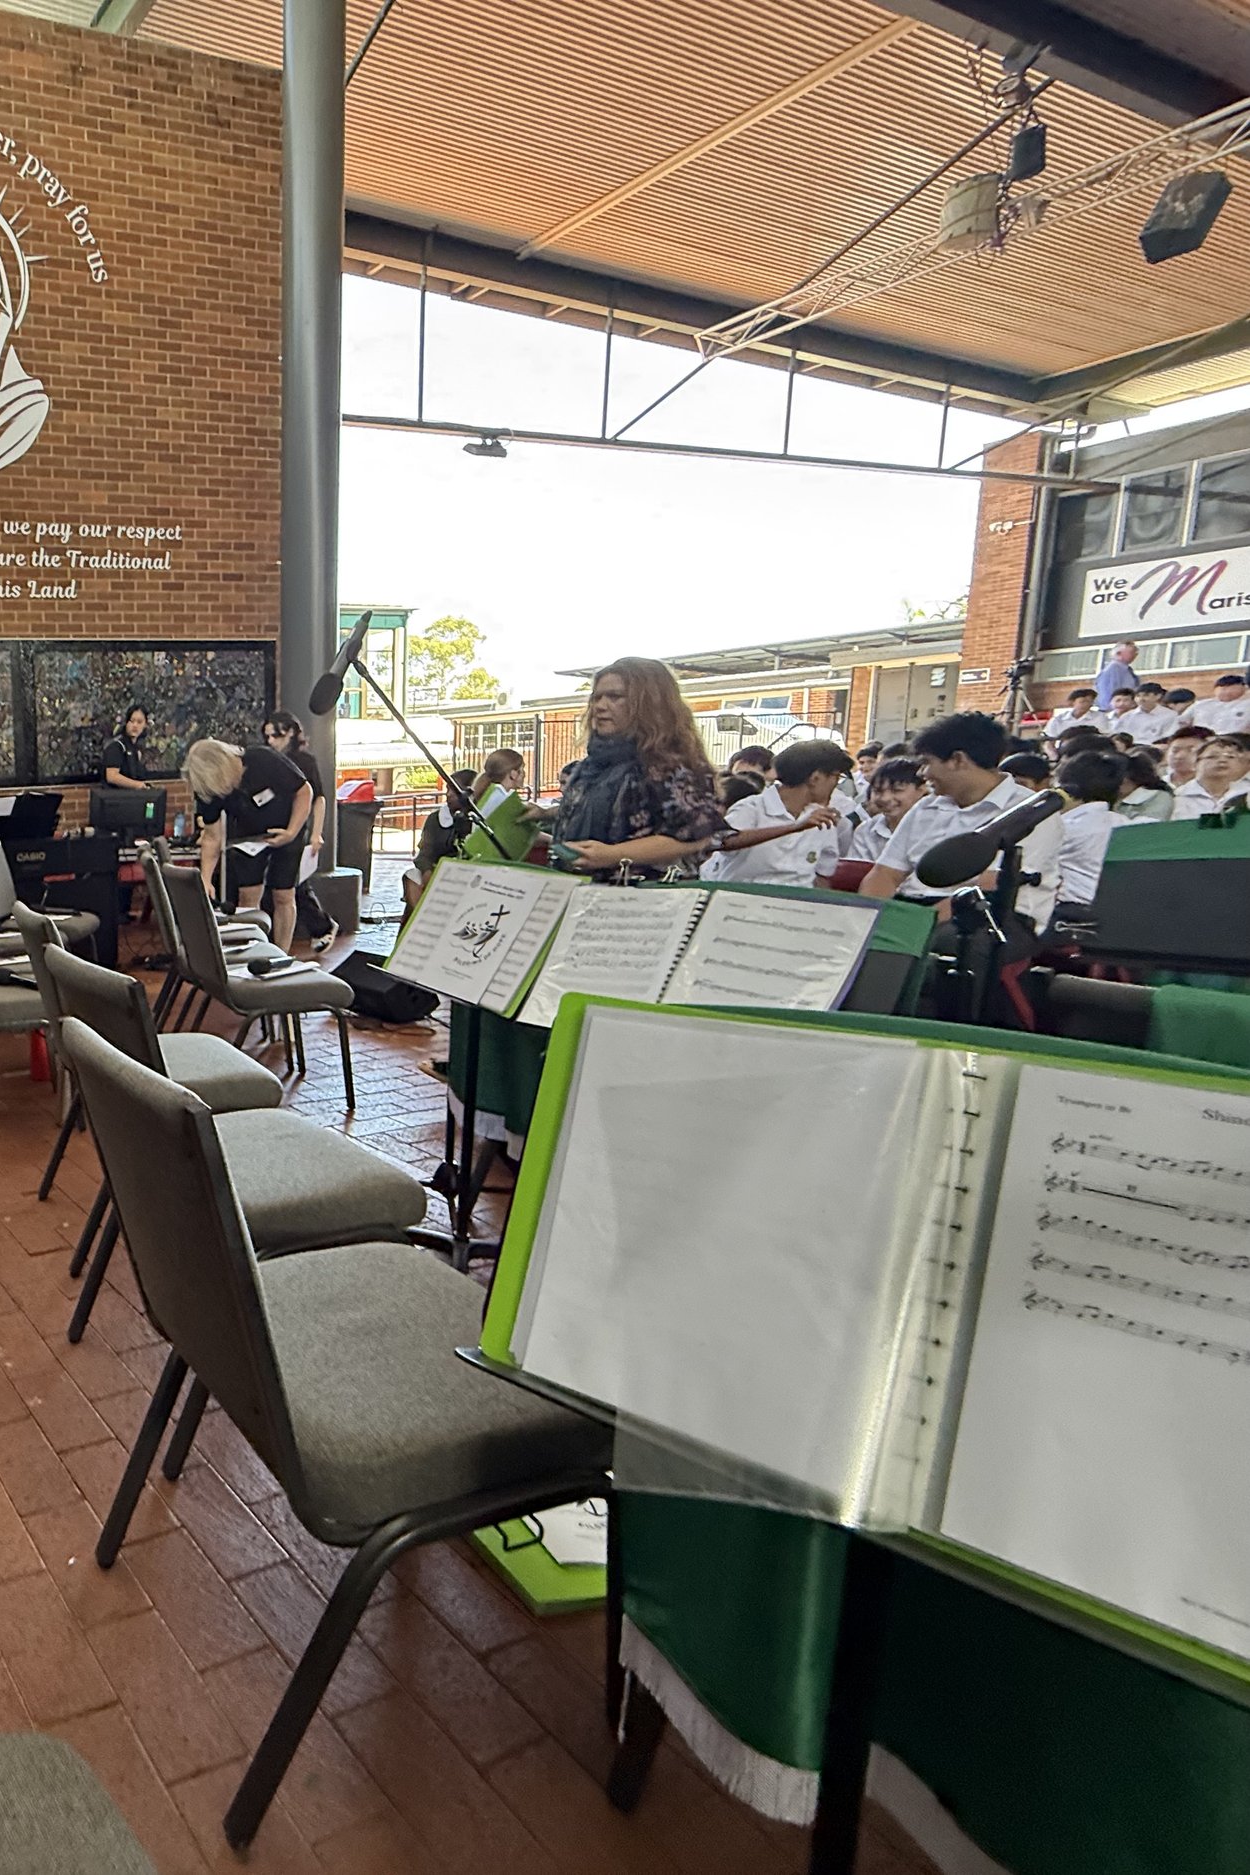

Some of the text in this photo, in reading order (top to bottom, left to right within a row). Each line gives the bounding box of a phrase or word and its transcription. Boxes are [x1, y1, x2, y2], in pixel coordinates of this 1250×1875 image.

[17, 152, 73, 208] pray
[65, 204, 97, 247] for
[86, 249, 109, 283] us
[3, 520, 31, 535] we
[35, 520, 73, 544] pay
[78, 521, 112, 538] our
[116, 525, 183, 547] respect
[31, 547, 62, 568] the
[66, 549, 172, 570] Traditional
[27, 578, 78, 599] Land
[1093, 576, 1128, 591] We
[1091, 590, 1129, 605] are
[16, 851, 46, 862] CASIO
